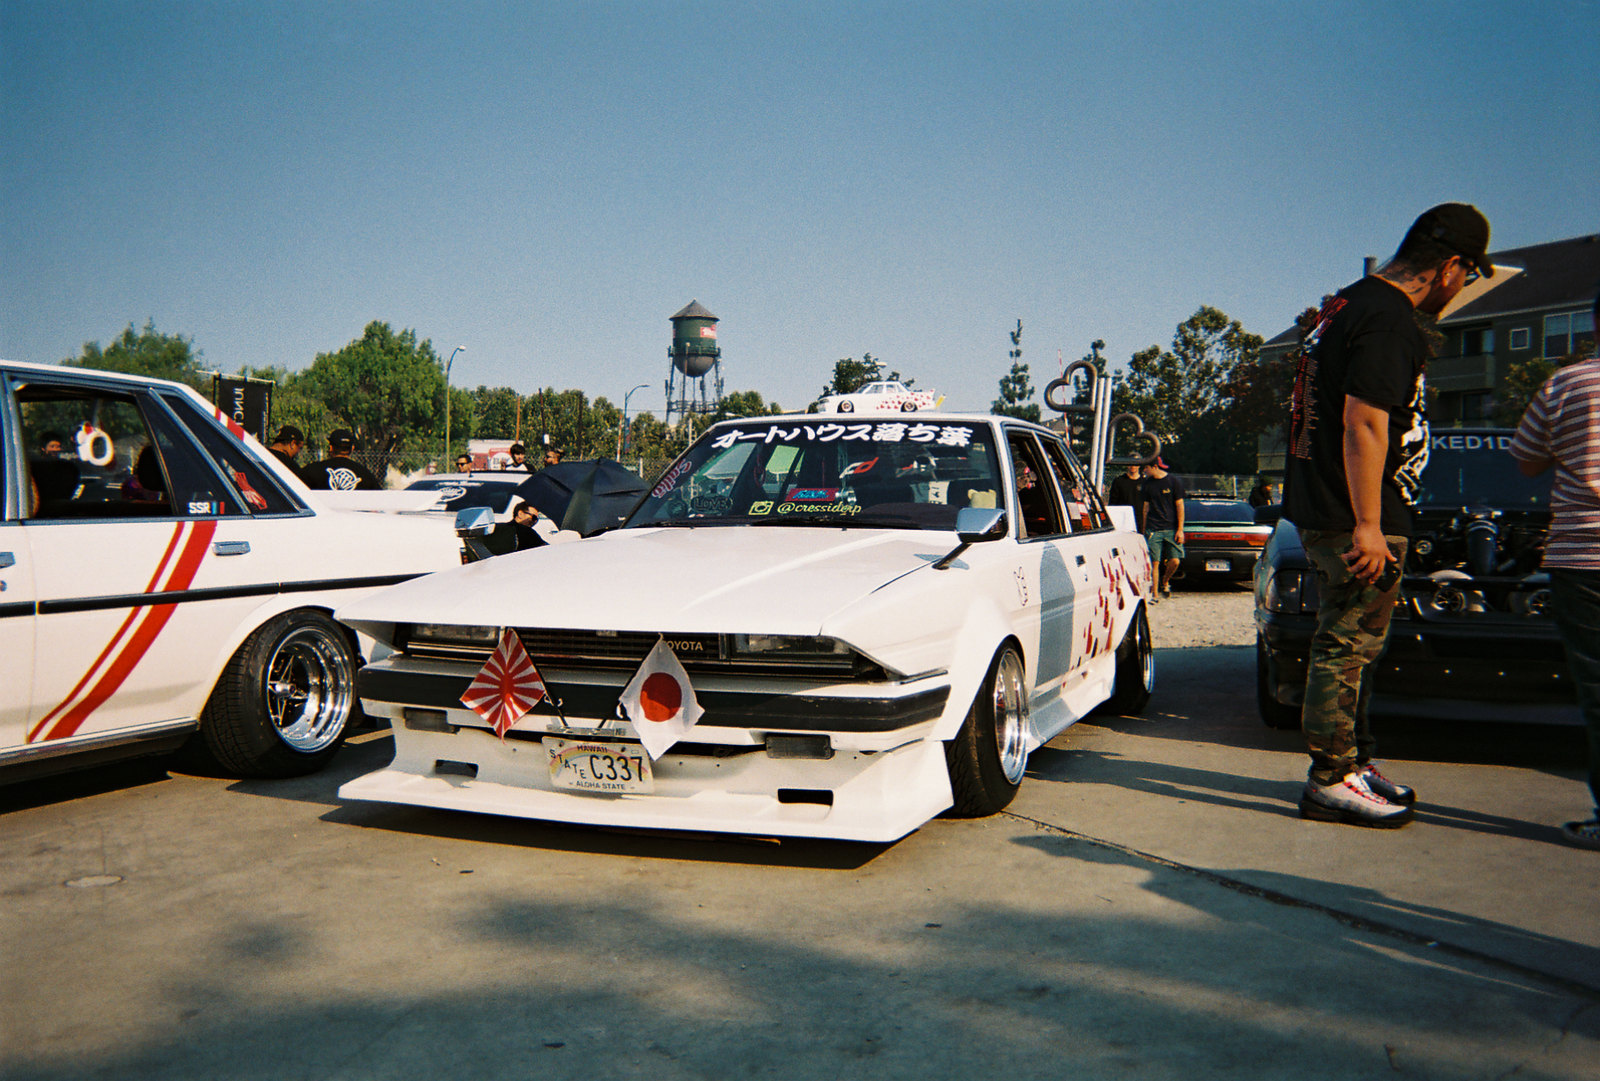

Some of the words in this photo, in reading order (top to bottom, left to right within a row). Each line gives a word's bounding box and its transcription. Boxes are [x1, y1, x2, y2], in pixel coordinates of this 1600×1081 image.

[711, 423, 973, 449] オートハウス落ち葉
[188, 501, 211, 514] SSR
[666, 640, 704, 651] OYOTA
[577, 744, 608, 753] HAWAII
[590, 754, 643, 781] C337
[576, 780, 601, 789] ALOHA
[602, 782, 625, 790] STATE
